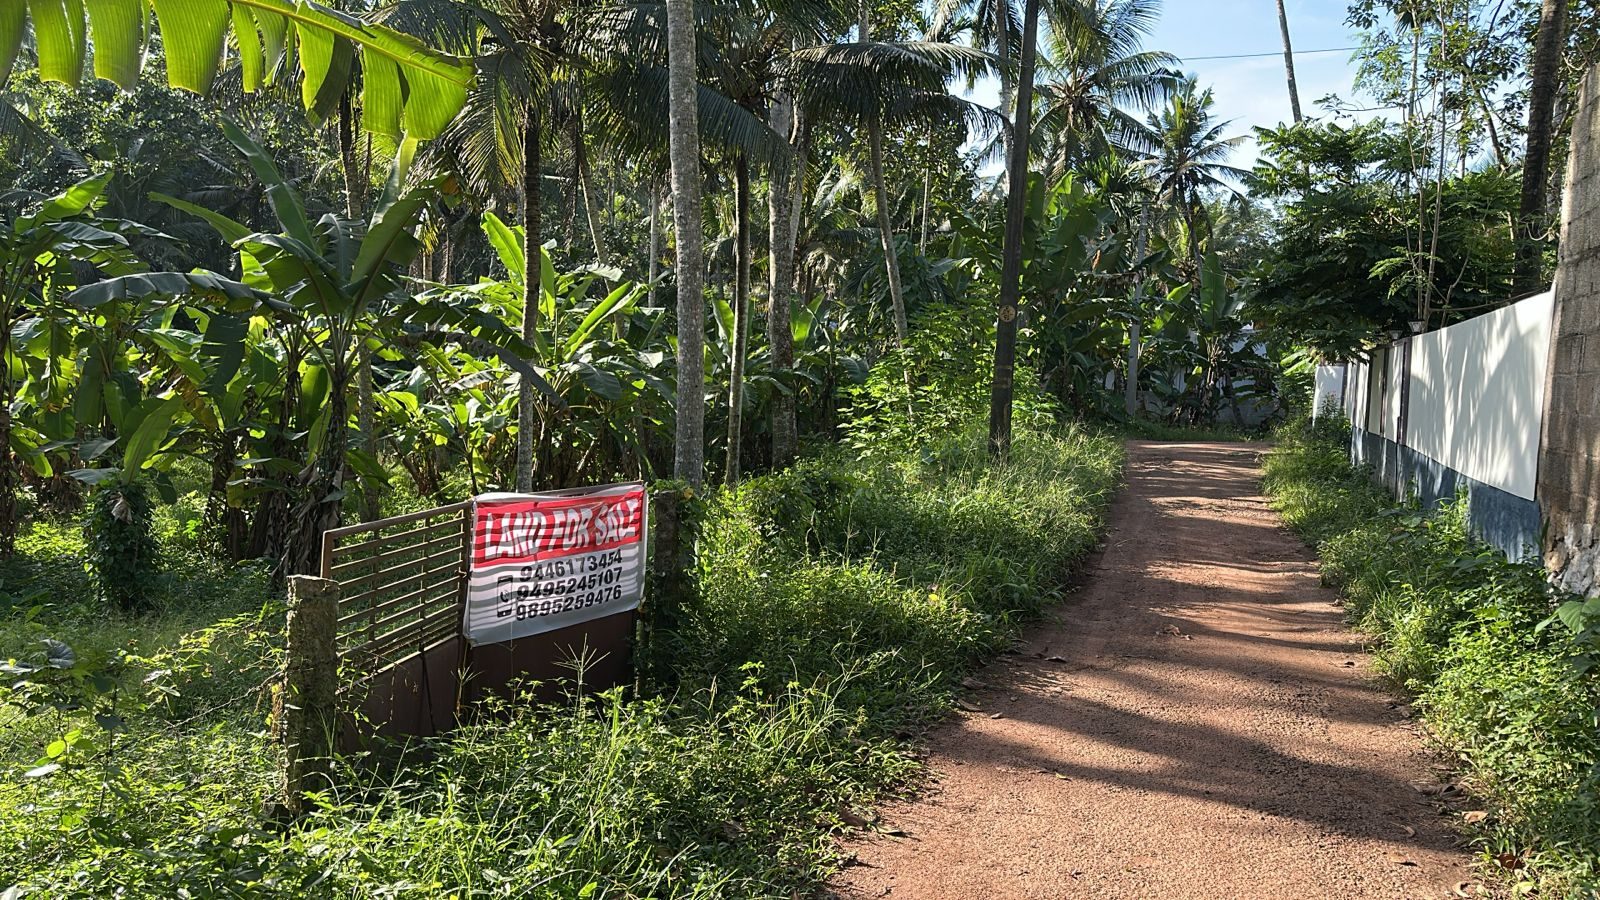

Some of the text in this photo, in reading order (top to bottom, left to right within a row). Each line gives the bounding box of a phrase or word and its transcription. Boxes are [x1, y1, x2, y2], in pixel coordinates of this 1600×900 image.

[485, 499, 640, 560] LAND FOR SALE
[519, 549, 623, 582] 9446173454
[516, 567, 623, 602] 9495245107
[516, 585, 622, 621] 9895259476
